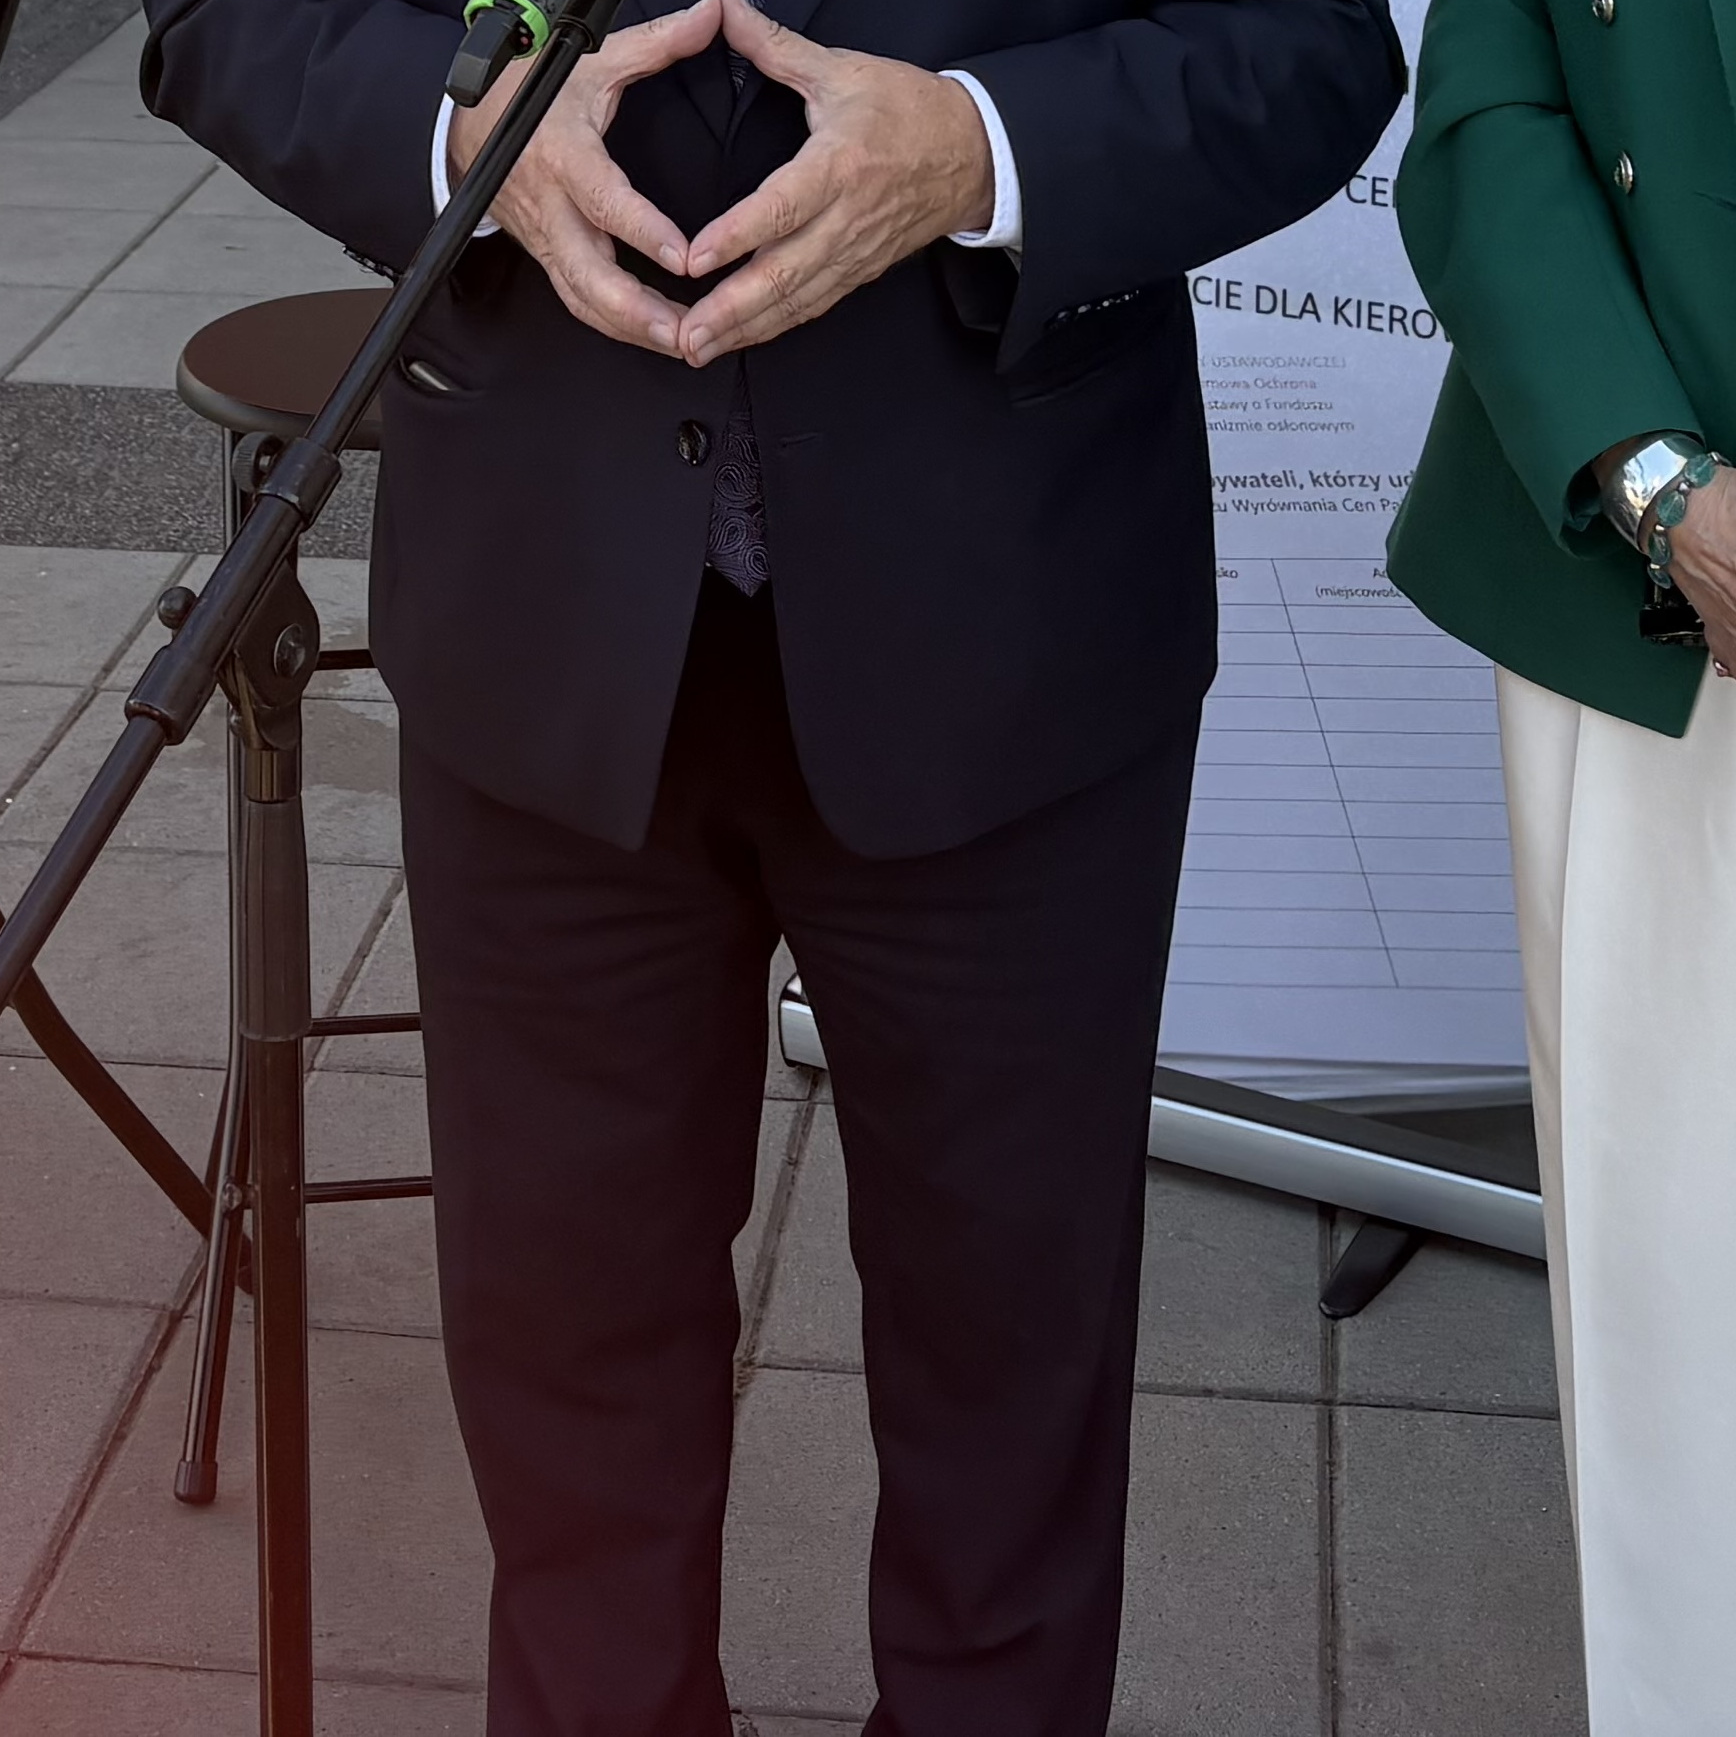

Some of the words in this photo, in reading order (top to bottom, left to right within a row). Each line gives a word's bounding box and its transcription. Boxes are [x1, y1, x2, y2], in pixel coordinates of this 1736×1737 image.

[1254, 284, 1322, 324] DLA
[1332, 295, 1451, 343] KIERO
[1253, 376, 1317, 391] Ochrona
[1265, 397, 1334, 412] Funduszu
[1266, 418, 1356, 435] osłonowym
[1309, 469, 1381, 492] którzy
[1231, 498, 1338, 516] Wyrównania
[1342, 498, 1376, 513] Cen
